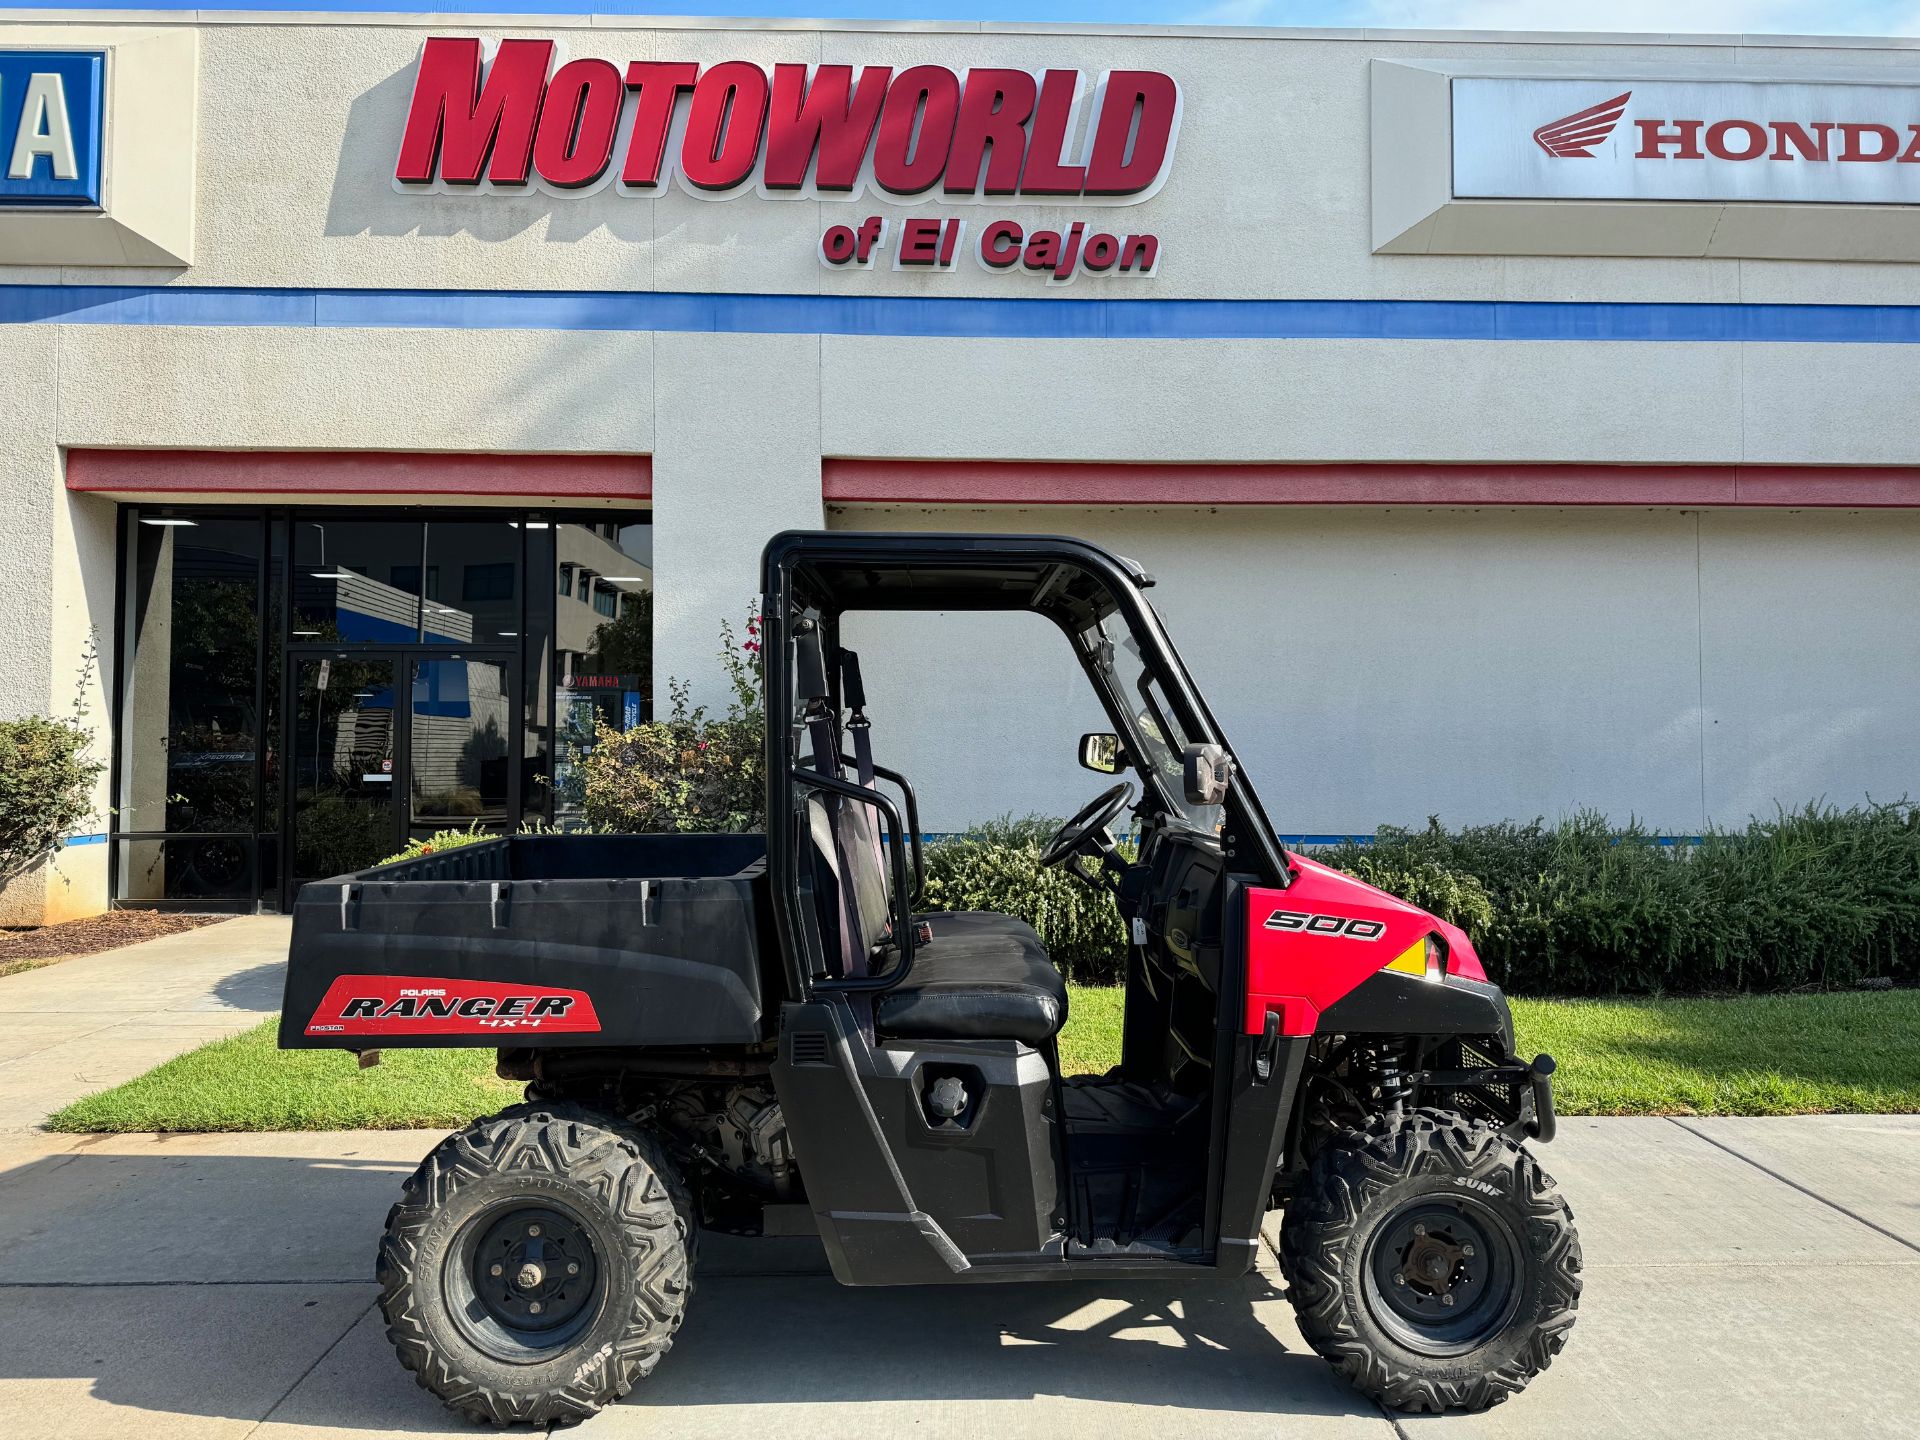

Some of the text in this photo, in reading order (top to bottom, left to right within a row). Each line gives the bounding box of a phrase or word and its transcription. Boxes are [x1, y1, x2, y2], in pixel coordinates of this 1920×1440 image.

[822, 217, 1160, 280] of El Cajon
[575, 676, 619, 687] YAMAHA
[1263, 909, 1387, 942] 500
[400, 989, 446, 997] POLARIS
[339, 996, 576, 1019] RANGER
[1452, 1176, 1505, 1196] SUNF
[572, 1341, 613, 1384] SUNF
